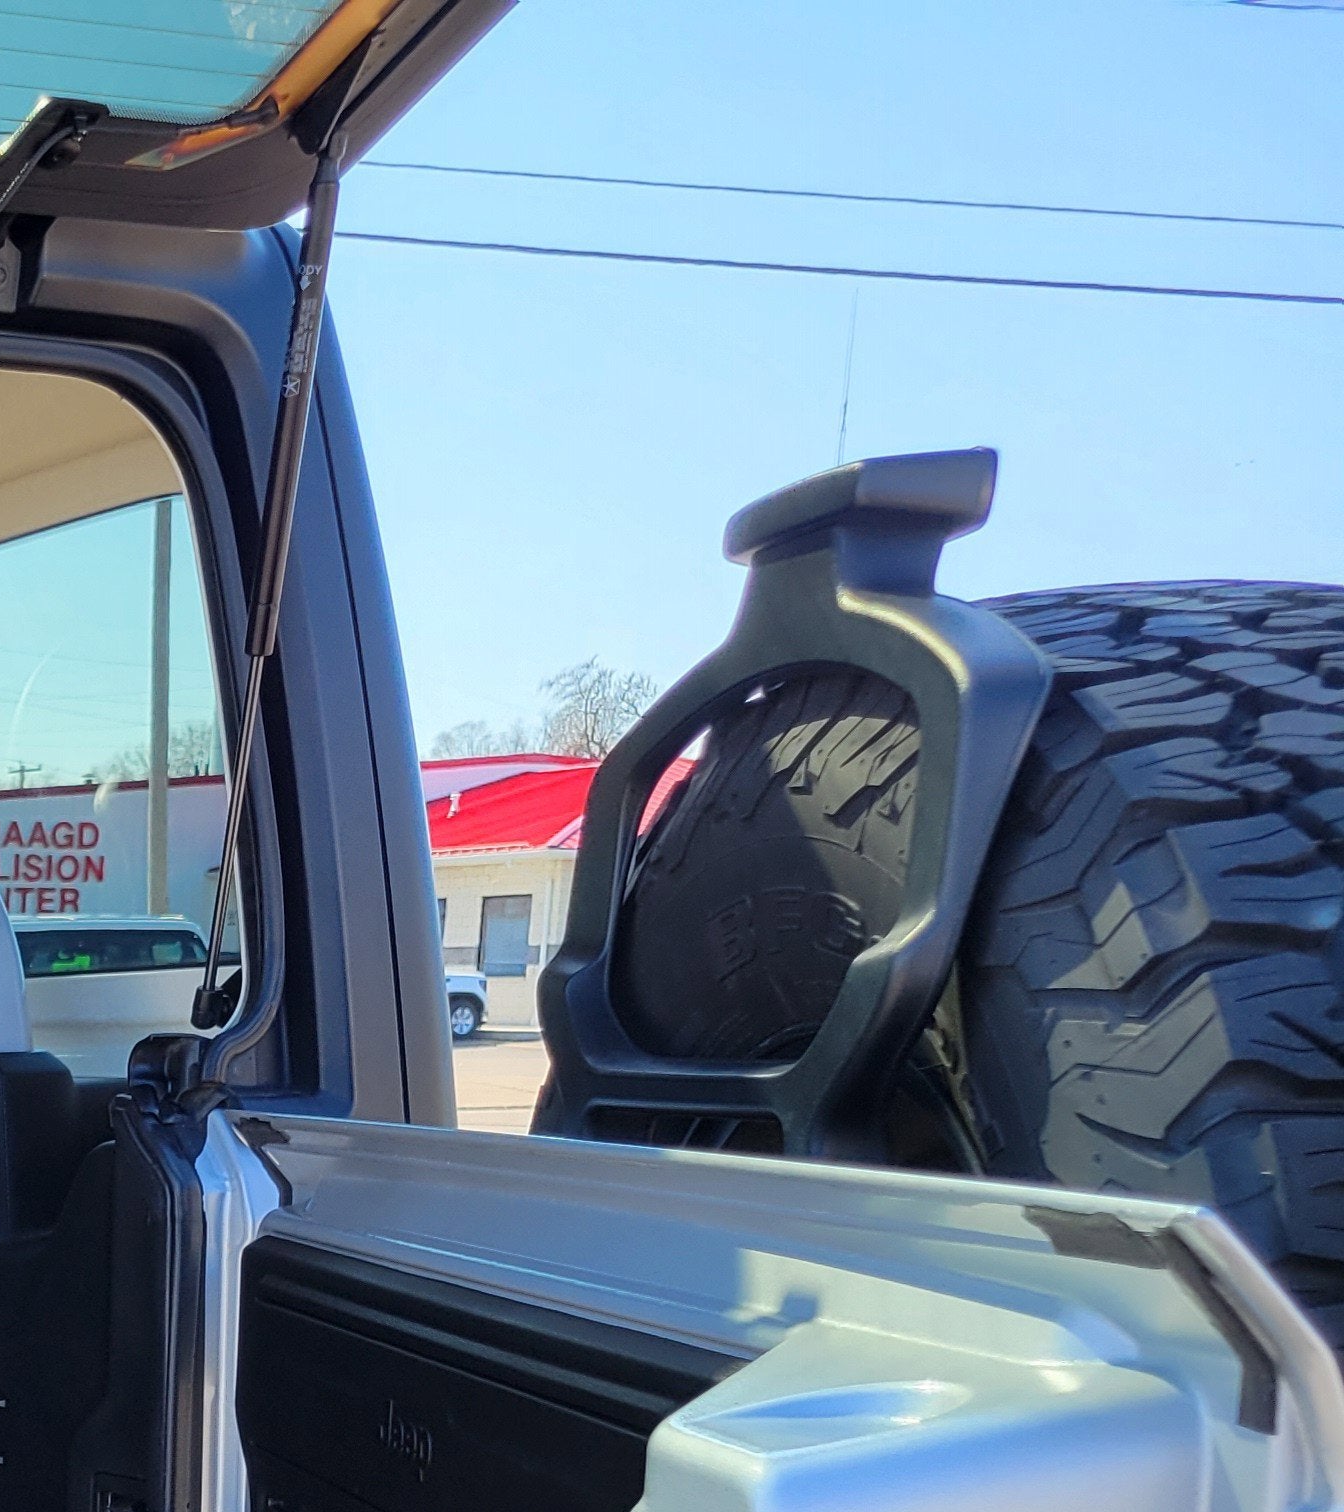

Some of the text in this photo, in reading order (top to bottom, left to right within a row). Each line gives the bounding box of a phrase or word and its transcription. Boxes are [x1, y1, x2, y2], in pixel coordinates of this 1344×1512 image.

[298, 264, 323, 276] ODY
[4, 887, 80, 914] TER
[380, 1399, 433, 1483] Jeep
